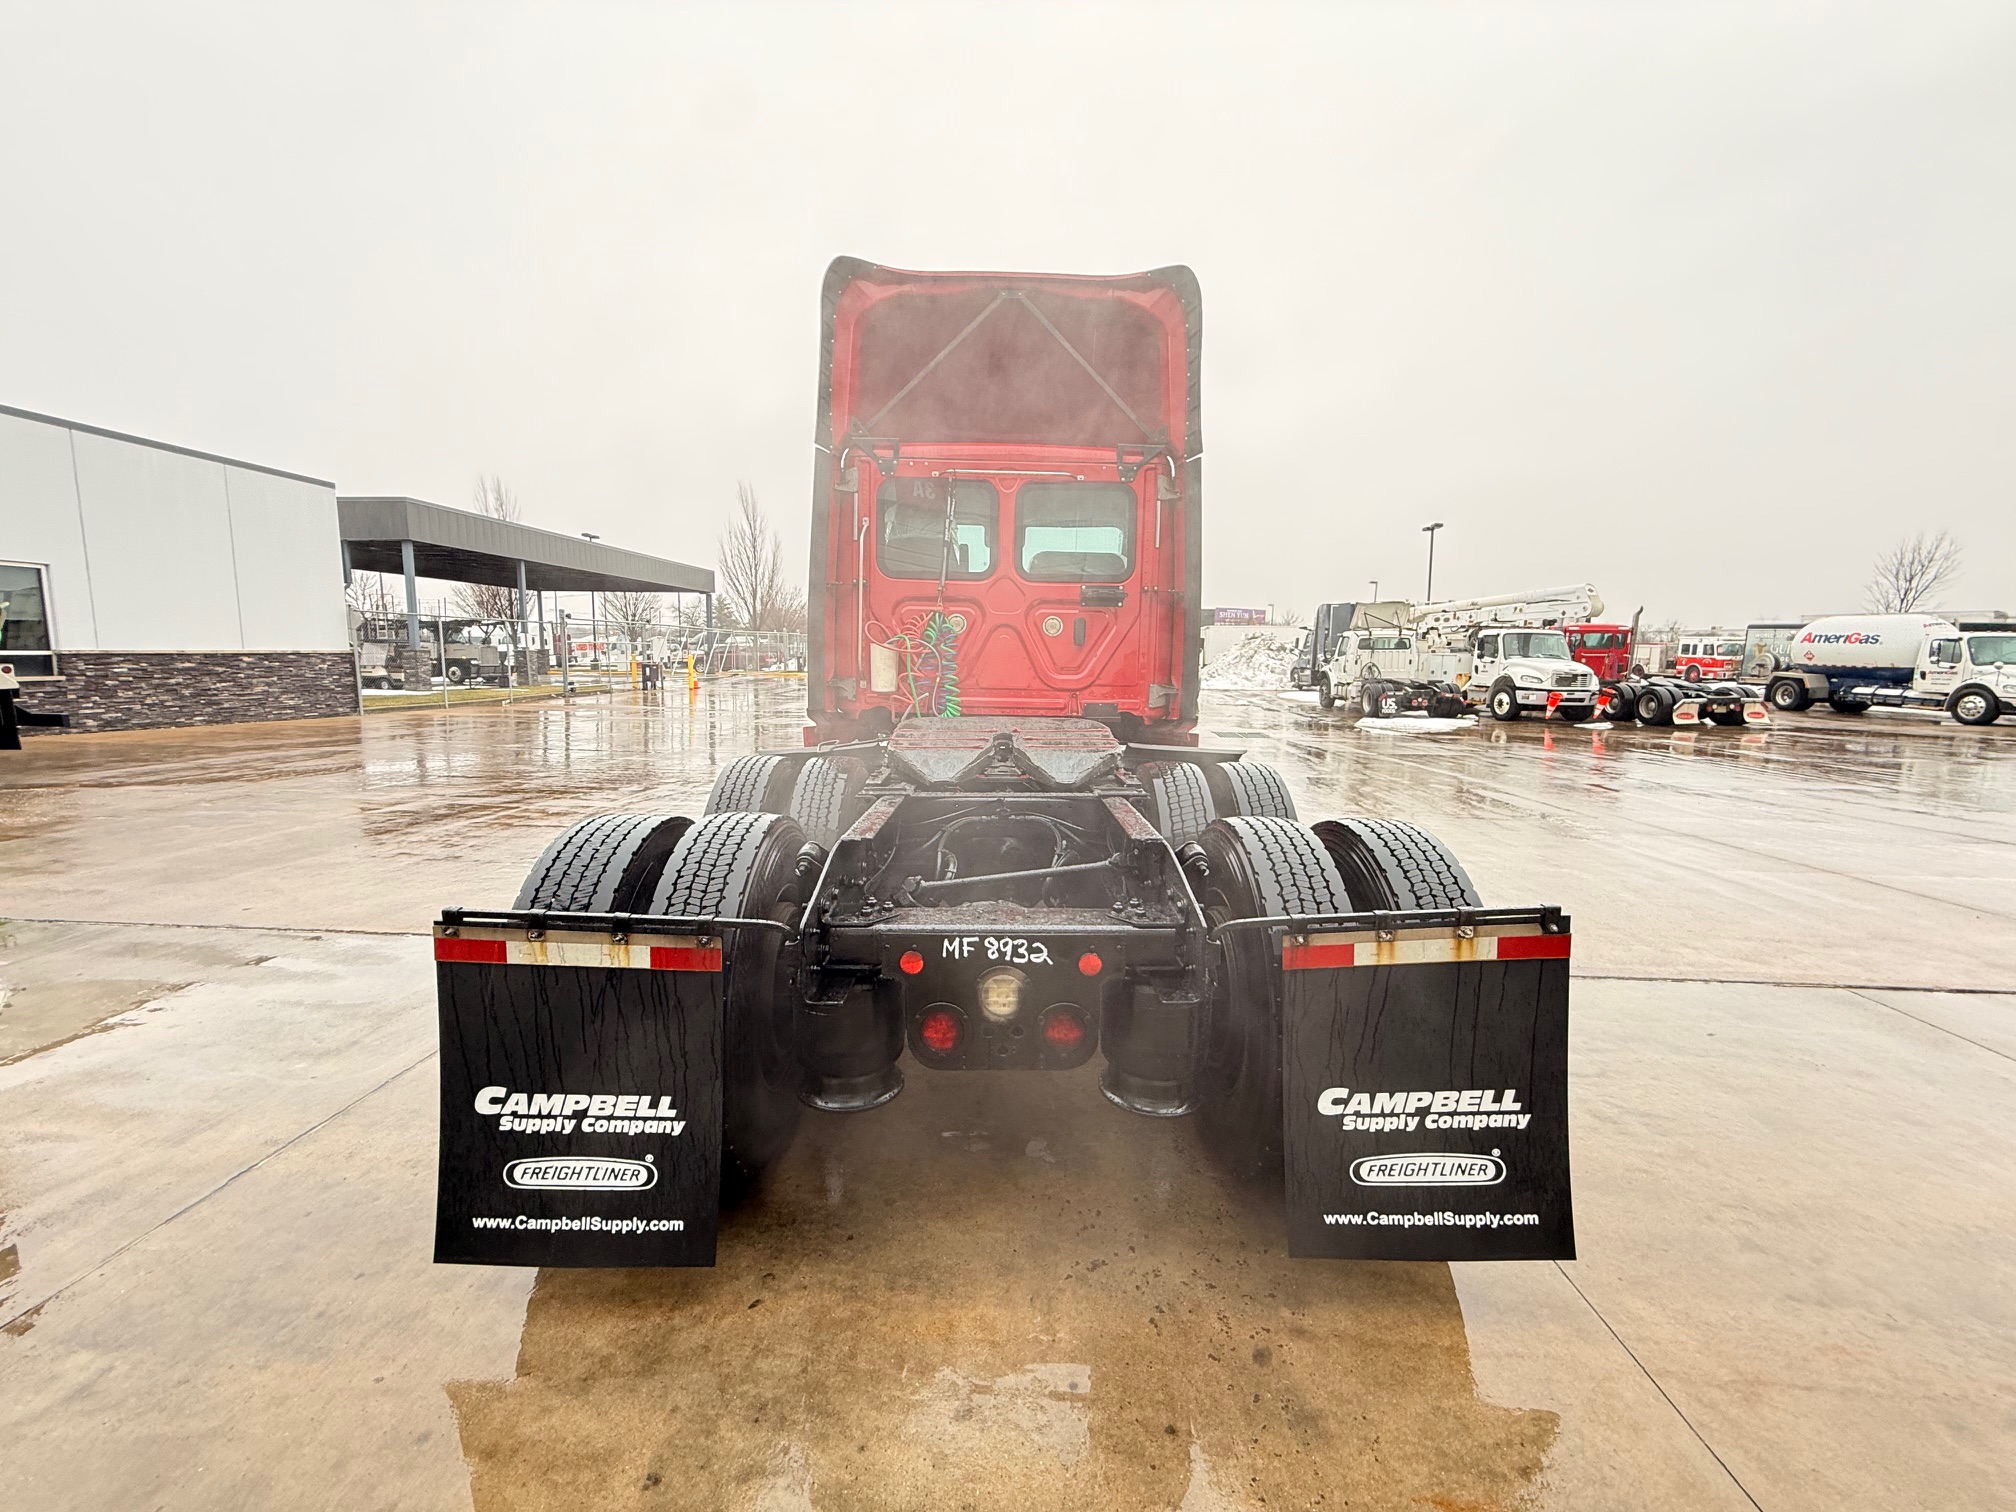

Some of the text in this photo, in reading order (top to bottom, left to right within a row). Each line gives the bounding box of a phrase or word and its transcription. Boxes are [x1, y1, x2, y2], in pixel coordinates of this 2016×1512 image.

[1770, 641, 1791, 654] GUI
[1800, 632, 1881, 645] AmeriGas
[942, 936, 1054, 966] MF 8932
[474, 1086, 678, 1118] CAMPBELL
[1317, 1087, 1522, 1116] CAMPBELL
[499, 1115, 687, 1136] Supply Company
[1342, 1113, 1532, 1132] Supply Company
[520, 1166, 641, 1182] FREIGHTLINER
[1367, 1162, 1489, 1178] FREIGHTLINER
[472, 1216, 685, 1234] www.CampbellSupply.com
[1323, 1211, 1540, 1229] www.CampbellSupply.com
